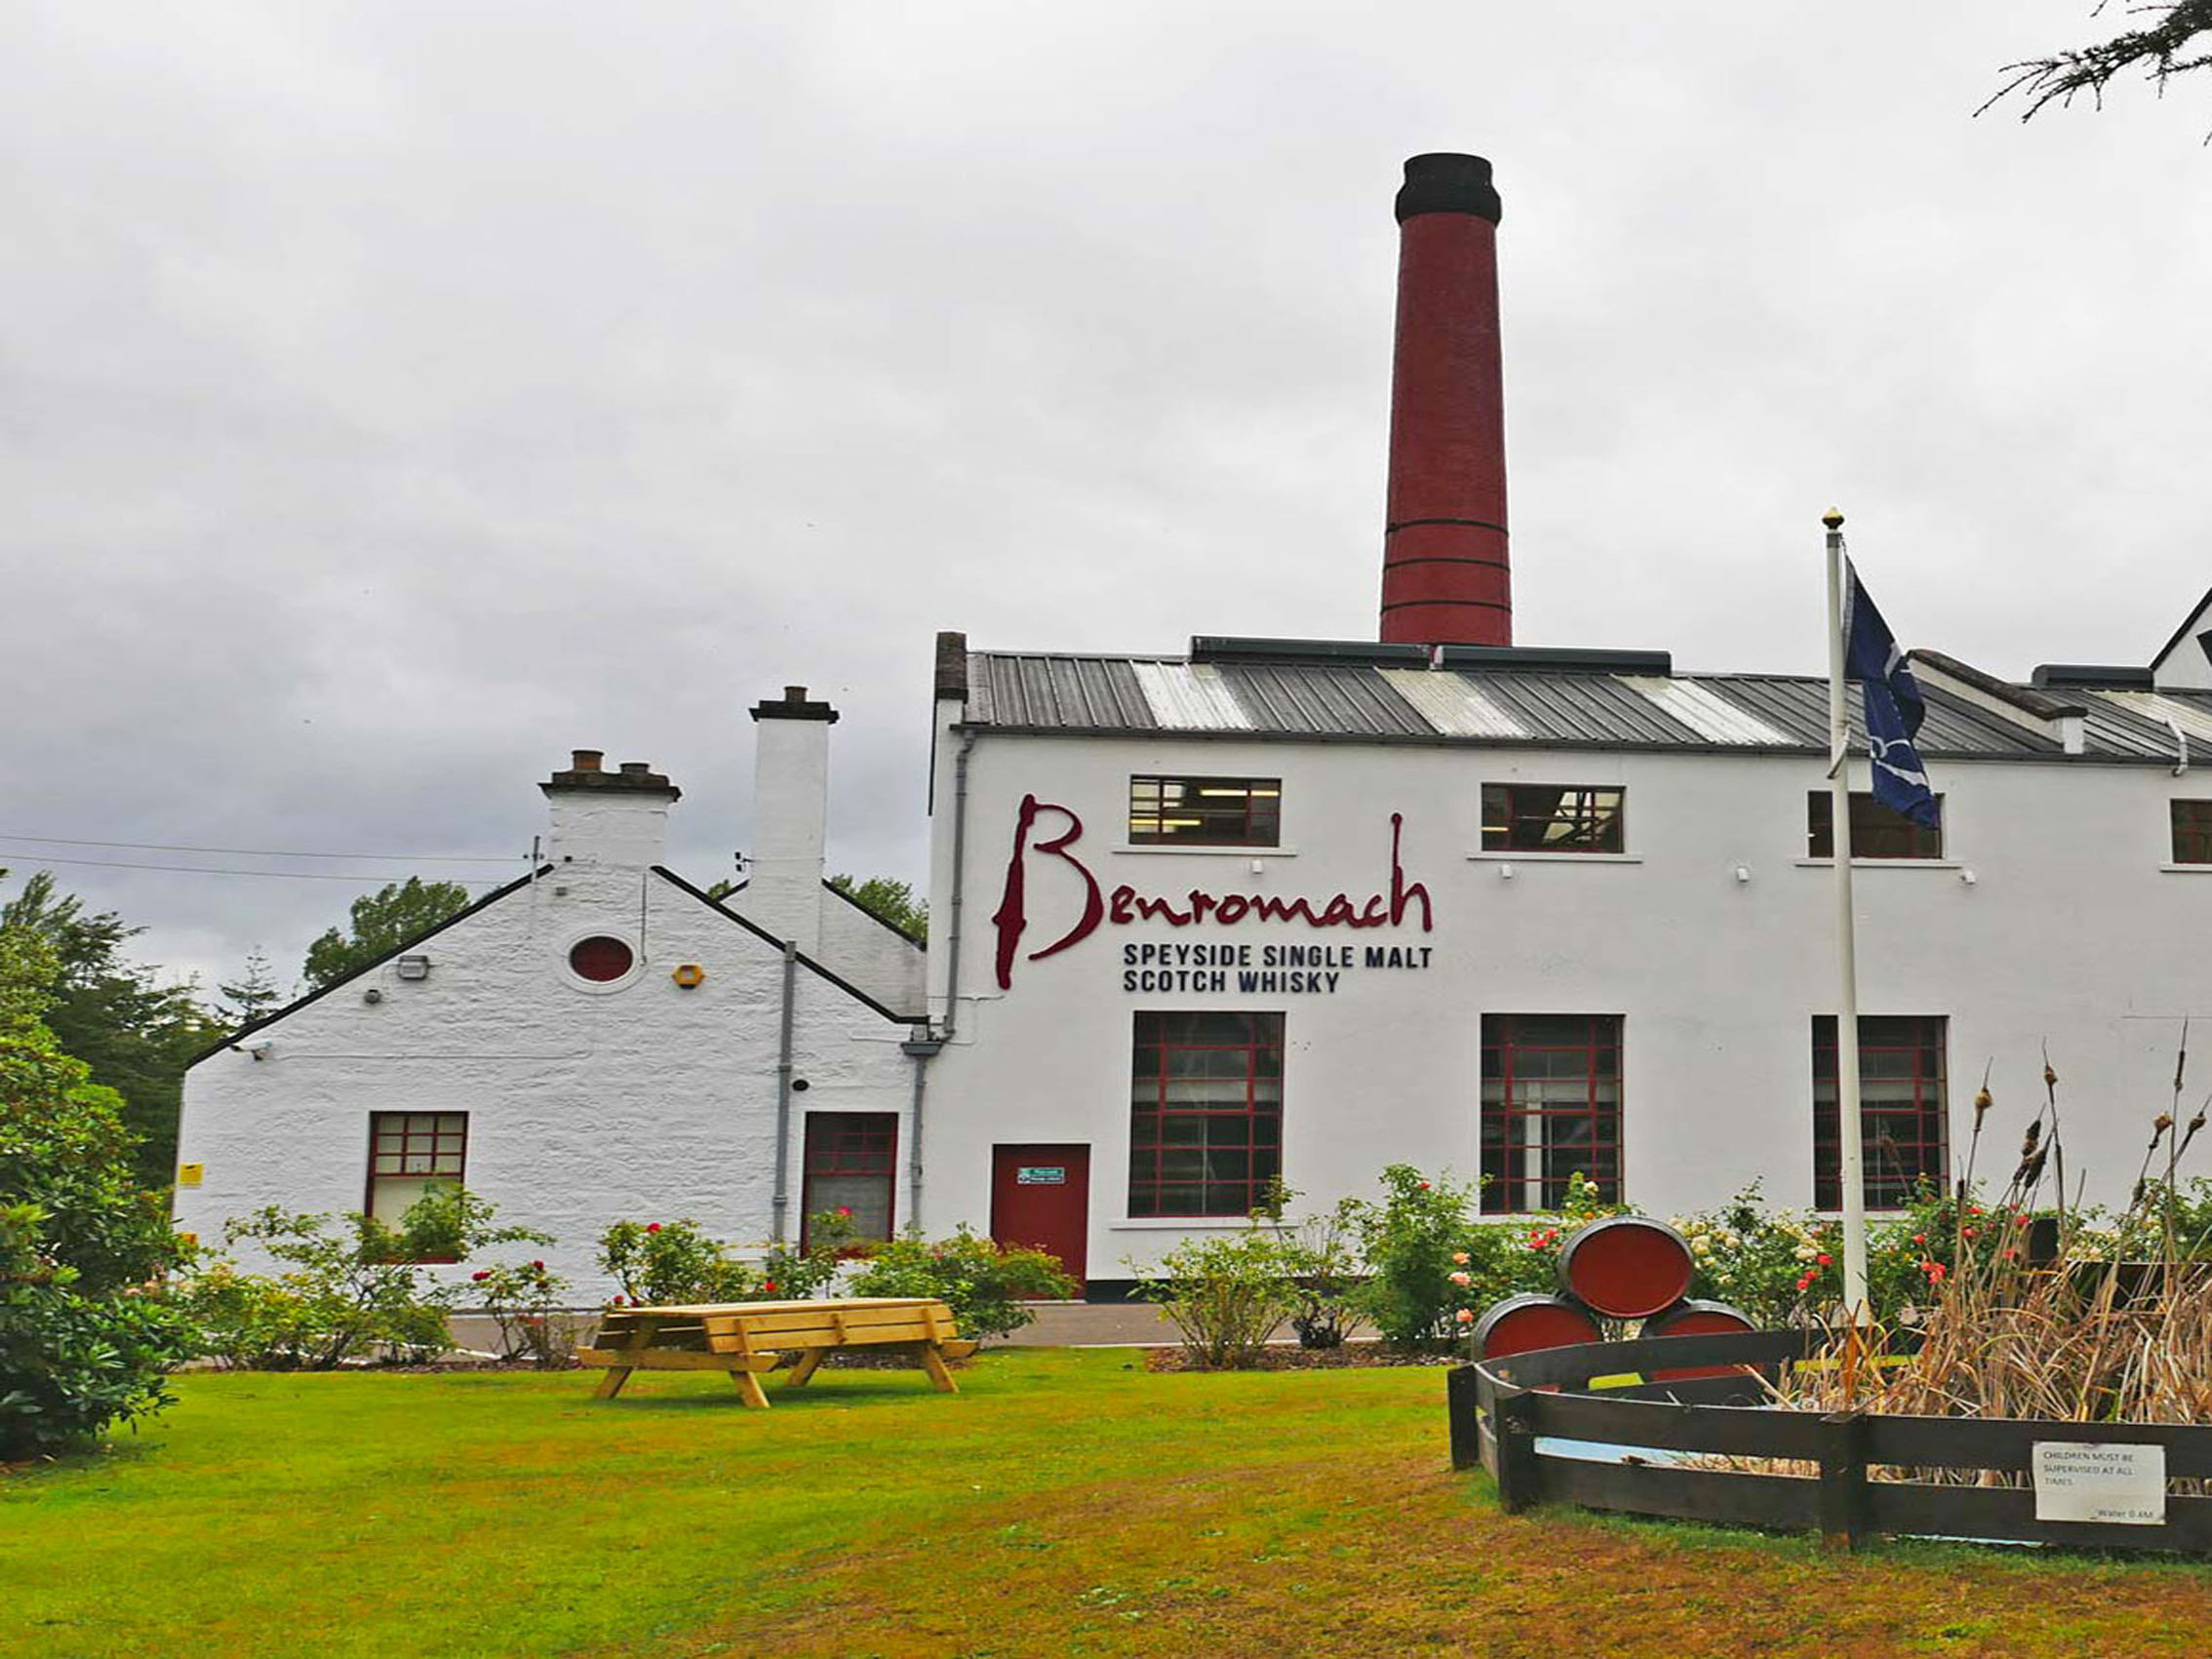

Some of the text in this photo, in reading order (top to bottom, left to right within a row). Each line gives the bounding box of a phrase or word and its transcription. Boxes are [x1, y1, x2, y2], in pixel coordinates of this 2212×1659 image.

[992, 794, 1432, 989] Benromach
[1124, 943, 1433, 968] SPEYSIDE SINGLE MALT
[1124, 969, 1340, 993] SCOTCH WHISKY
[2092, 1452, 2119, 1461] MUST
[2043, 1464, 2100, 1474] SUPERVISED
